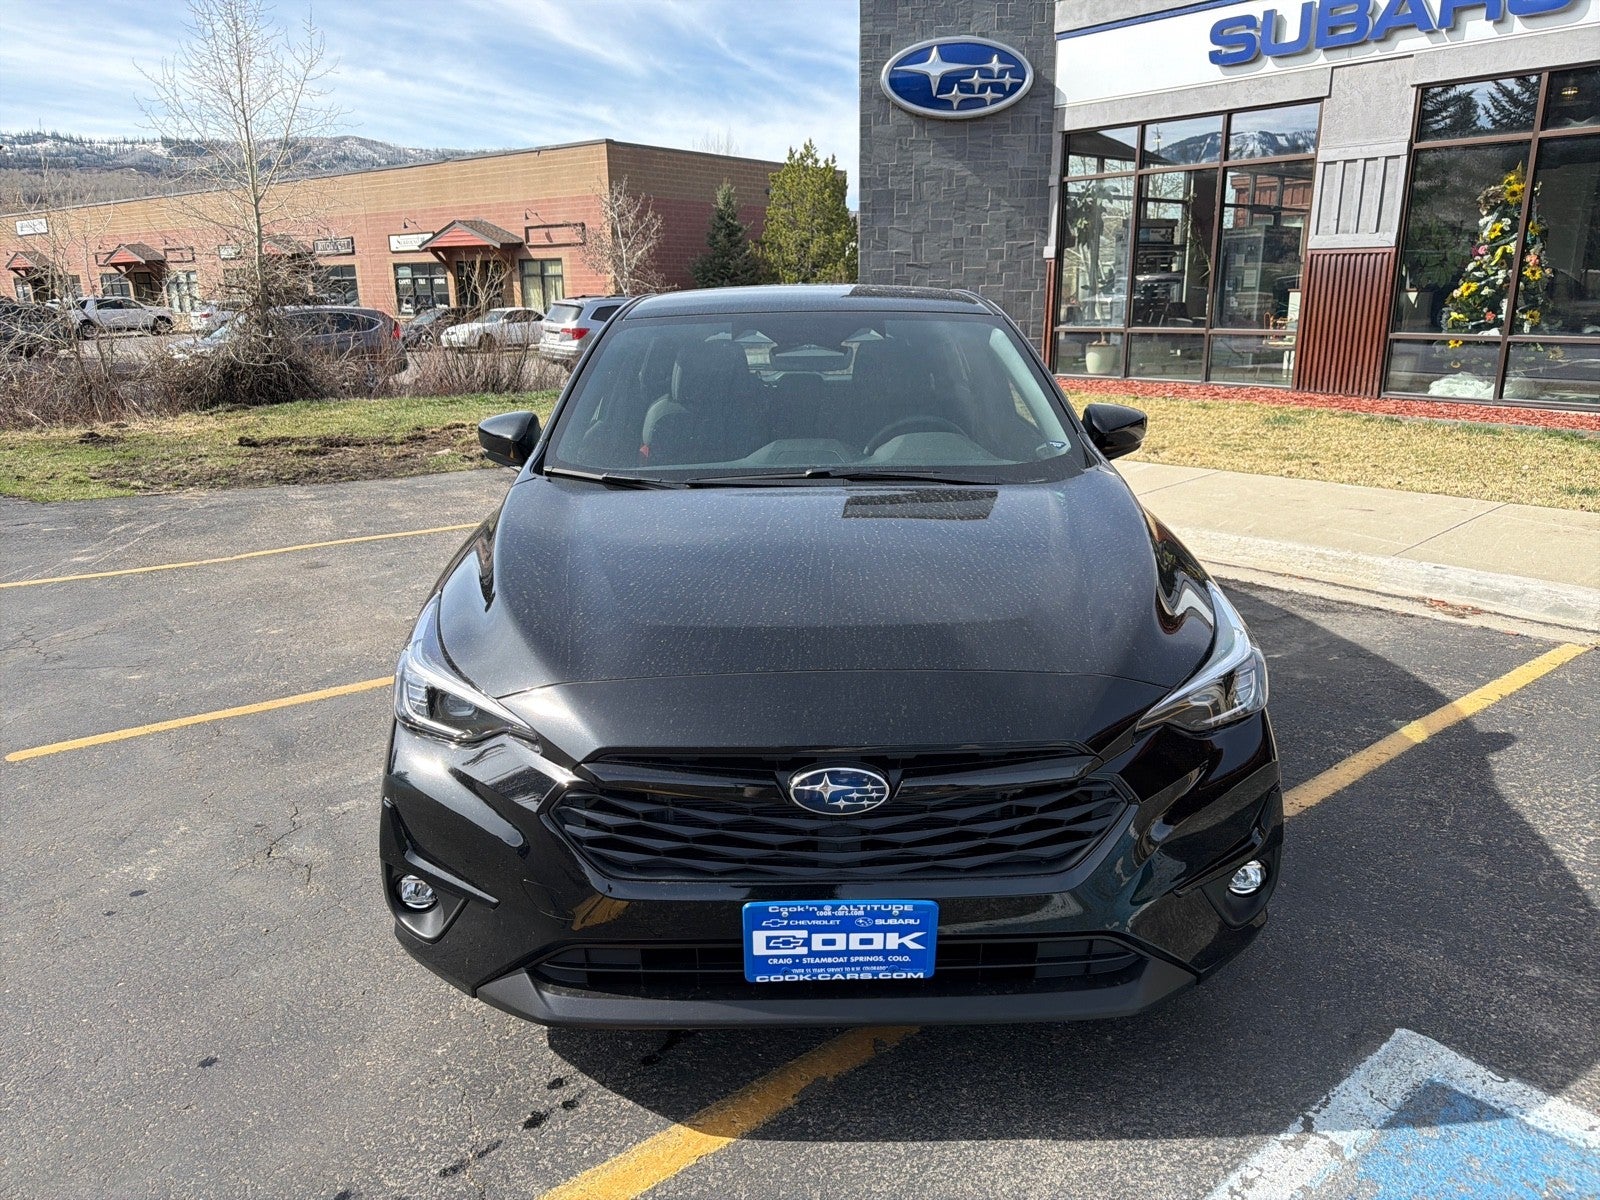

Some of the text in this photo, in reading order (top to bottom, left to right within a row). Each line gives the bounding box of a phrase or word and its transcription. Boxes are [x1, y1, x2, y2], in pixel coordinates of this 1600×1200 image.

[874, 918, 921, 926] SUBARU
[752, 929, 928, 956] COOK
[767, 957, 793, 965] CRAIG
[802, 956, 849, 964] STEAMBOAT
[850, 955, 886, 963] SPRINGS,
[755, 972, 925, 983] COOK-CARS.COM
